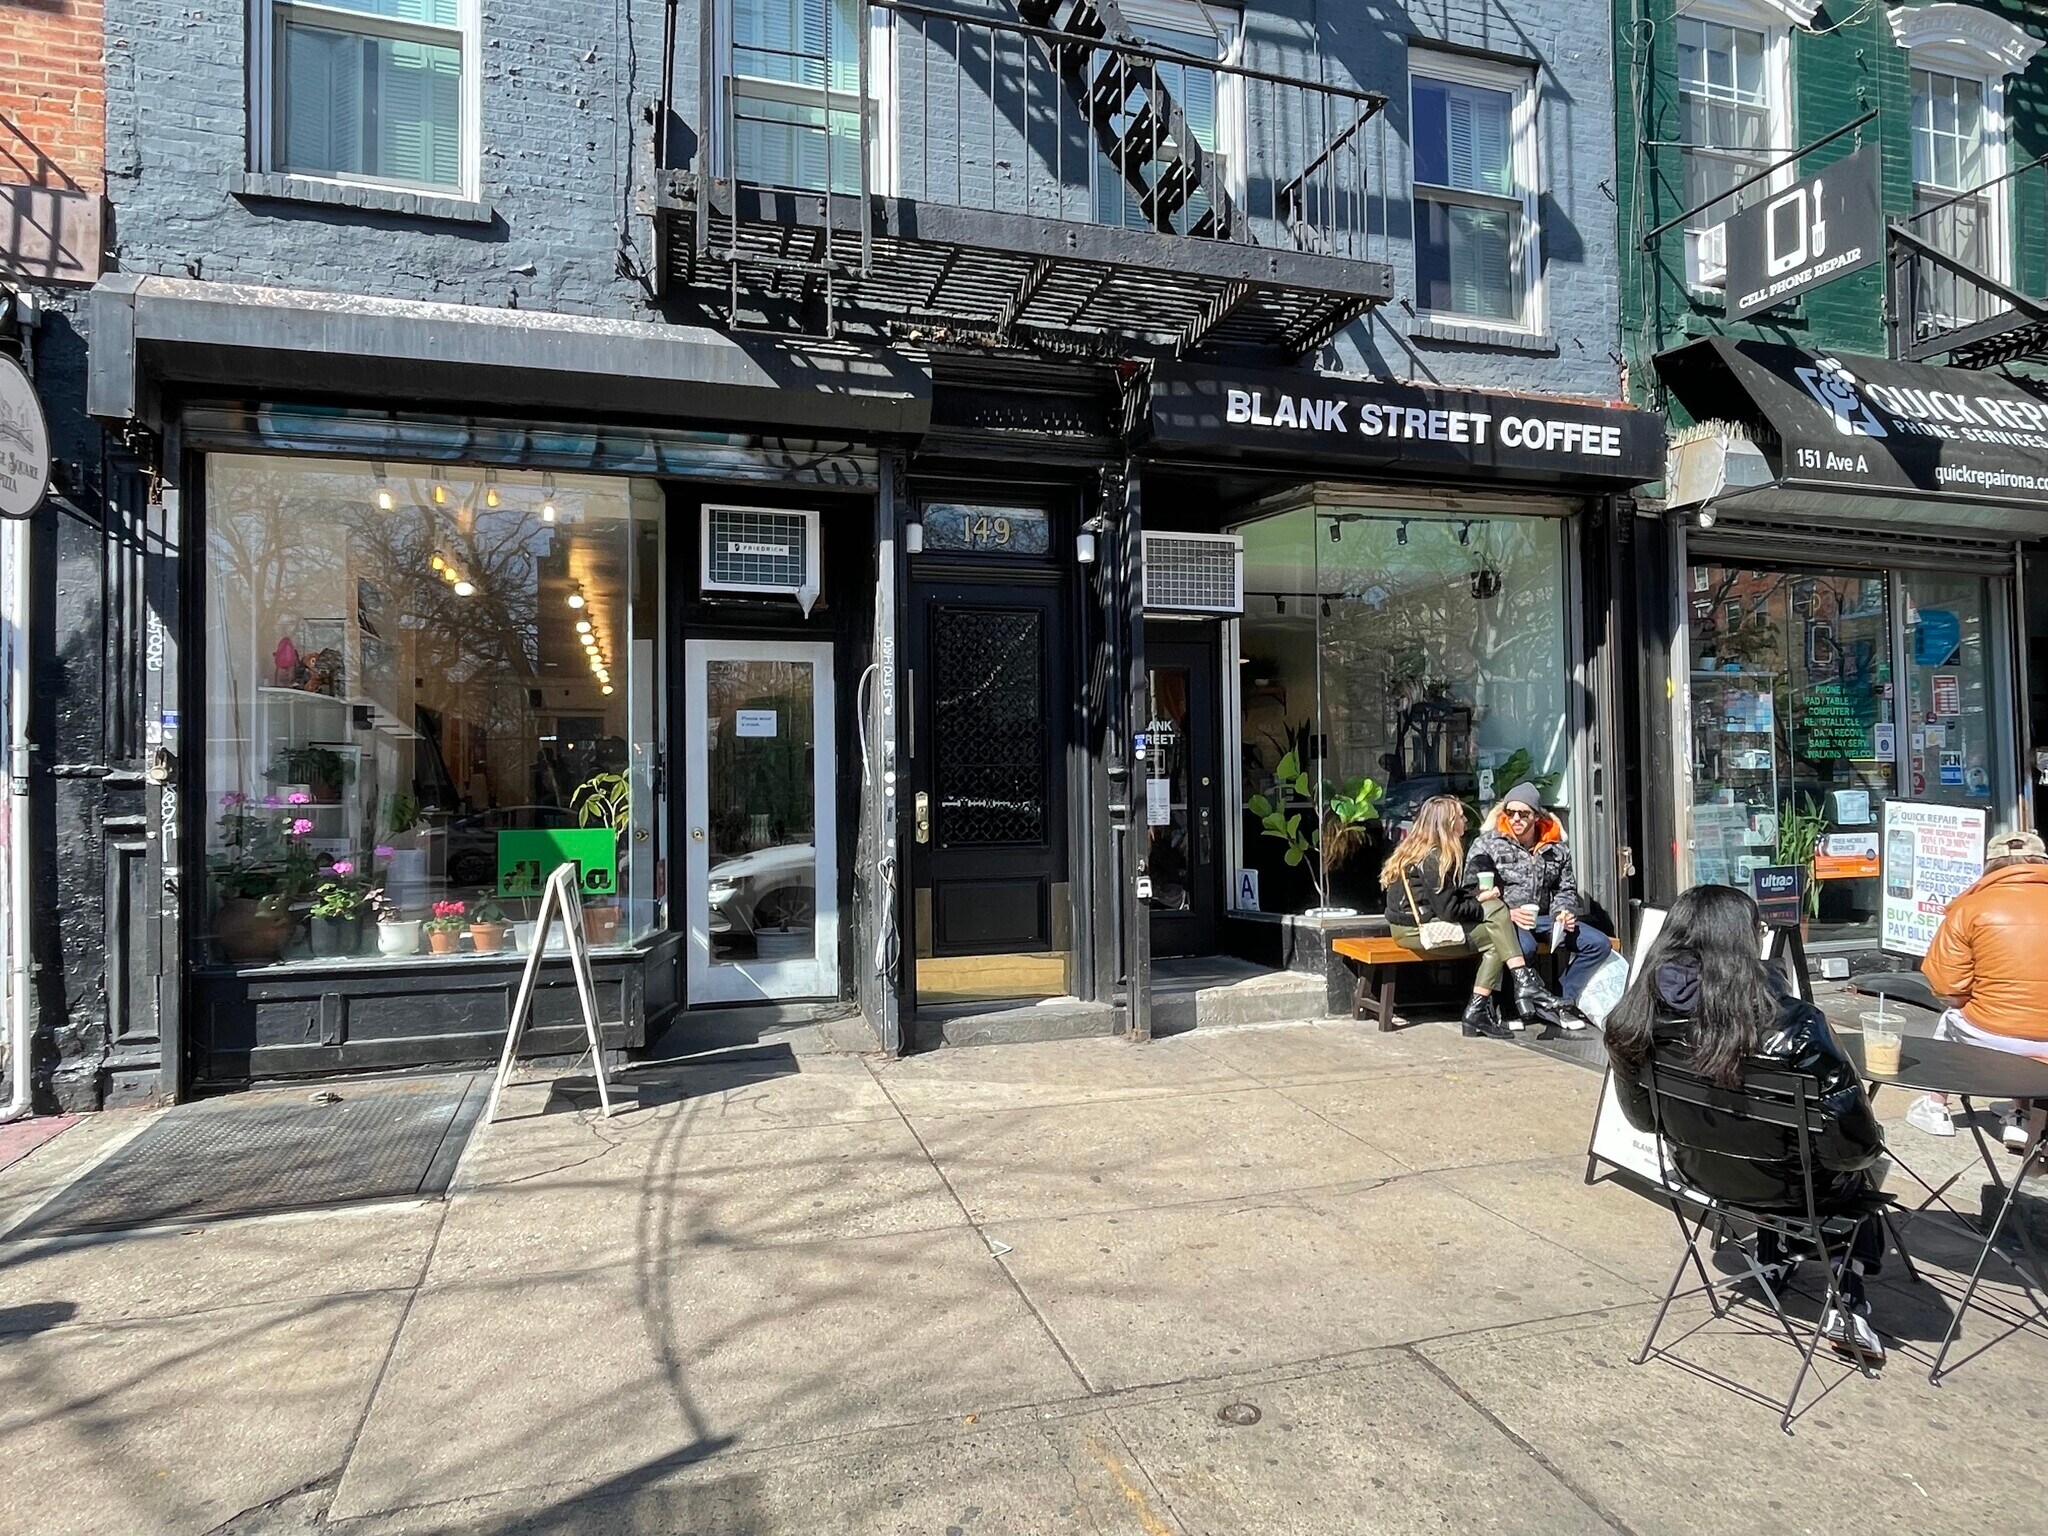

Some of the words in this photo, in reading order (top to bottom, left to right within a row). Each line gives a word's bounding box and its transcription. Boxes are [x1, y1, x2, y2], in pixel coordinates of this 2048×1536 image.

[1739, 289, 1768, 309] CELL
[1769, 268, 1813, 297] PHONE
[1813, 247, 1862, 278] REPAIR
[1865, 383, 1988, 426] QUICK
[1975, 396, 2048, 432] REP
[1226, 389, 1348, 433] BLANK
[1359, 403, 1492, 444] STREET
[1500, 416, 1621, 457] COFFEE
[1892, 419, 1960, 440] PHONE
[1960, 427, 2048, 450] SERVICES
[1797, 448, 1821, 469] 151
[1826, 451, 1853, 471] Ave
[1856, 454, 1869, 473] A
[1934, 464, 2048, 490] quickrepairona.co
[964, 516, 1010, 544] 149
[1815, 685, 1841, 694] PHONE
[1825, 696, 1850, 705] TABLE
[1808, 707, 1850, 715] COMPUTER
[1145, 720, 1172, 731] ANK
[1813, 728, 1833, 737] DATA
[1834, 728, 1865, 737] RECOVE
[1145, 734, 1175, 745] REET
[1808, 739, 1831, 747] SAME
[1847, 739, 1870, 748] SERV
[1901, 812, 1925, 822] QUICK
[1927, 814, 1958, 824] REPAIR
[1922, 844, 1938, 855] FREE
[1920, 871, 1973, 885] ACCESSORIES
[1241, 874, 1254, 900] A
[1916, 880, 1946, 894] PREPAID
[1921, 903, 1947, 914] INS
[1888, 922, 1905, 937] PAY
[1907, 926, 1933, 942] BILLS
[1632, 1139, 1653, 1155] BLANK
